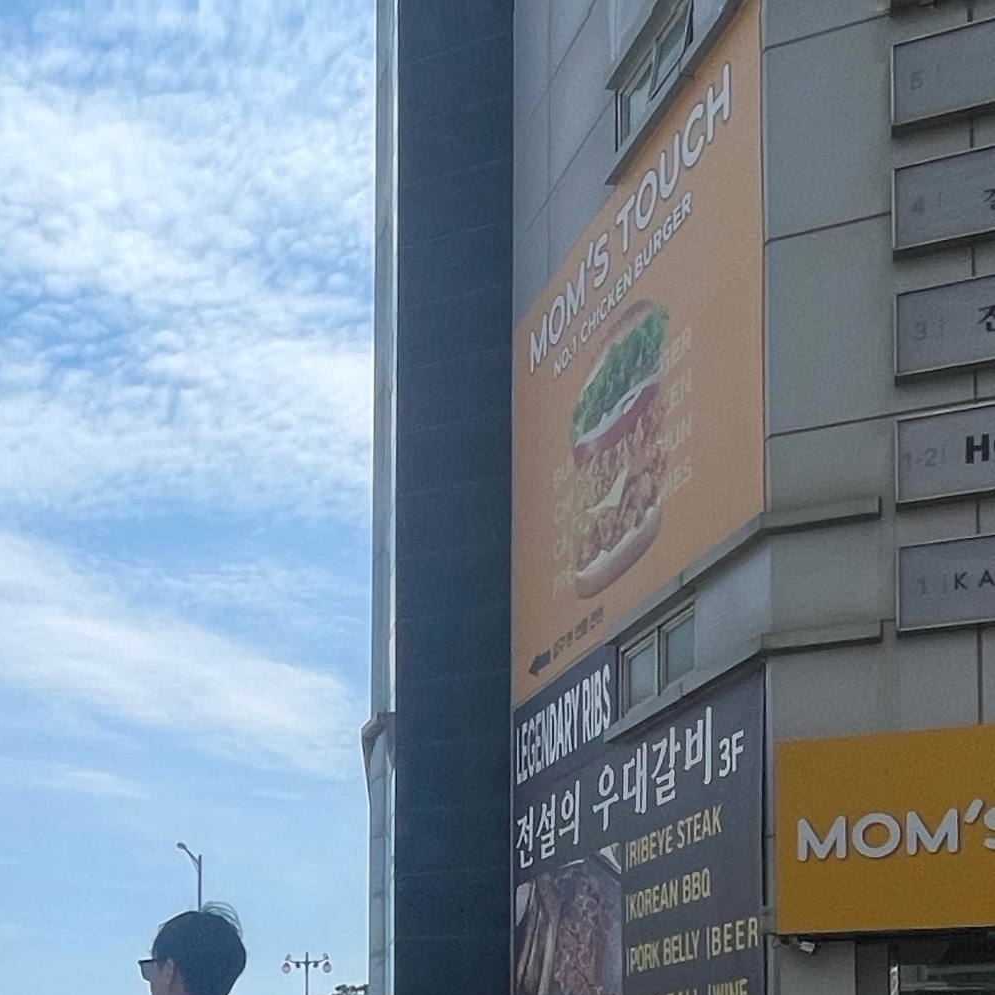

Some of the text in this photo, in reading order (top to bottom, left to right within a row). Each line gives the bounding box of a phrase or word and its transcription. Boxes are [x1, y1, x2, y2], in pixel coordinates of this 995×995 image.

[528, 63, 731, 374] MOM'S TOUCH
[552, 339, 578, 379] NO.1
[579, 265, 633, 344] CHICKEN
[633, 191, 693, 280] BURGER
[964, 433, 995, 464] H
[516, 663, 611, 786] LEGENDARY RIBS
[515, 705, 745, 869] 전설의 우대갈비 3F
[629, 803, 723, 868] RIBEYE STEAK
[629, 868, 712, 921] KOREAN BBQ
[629, 916, 759, 974] PORK BELLY BEER
